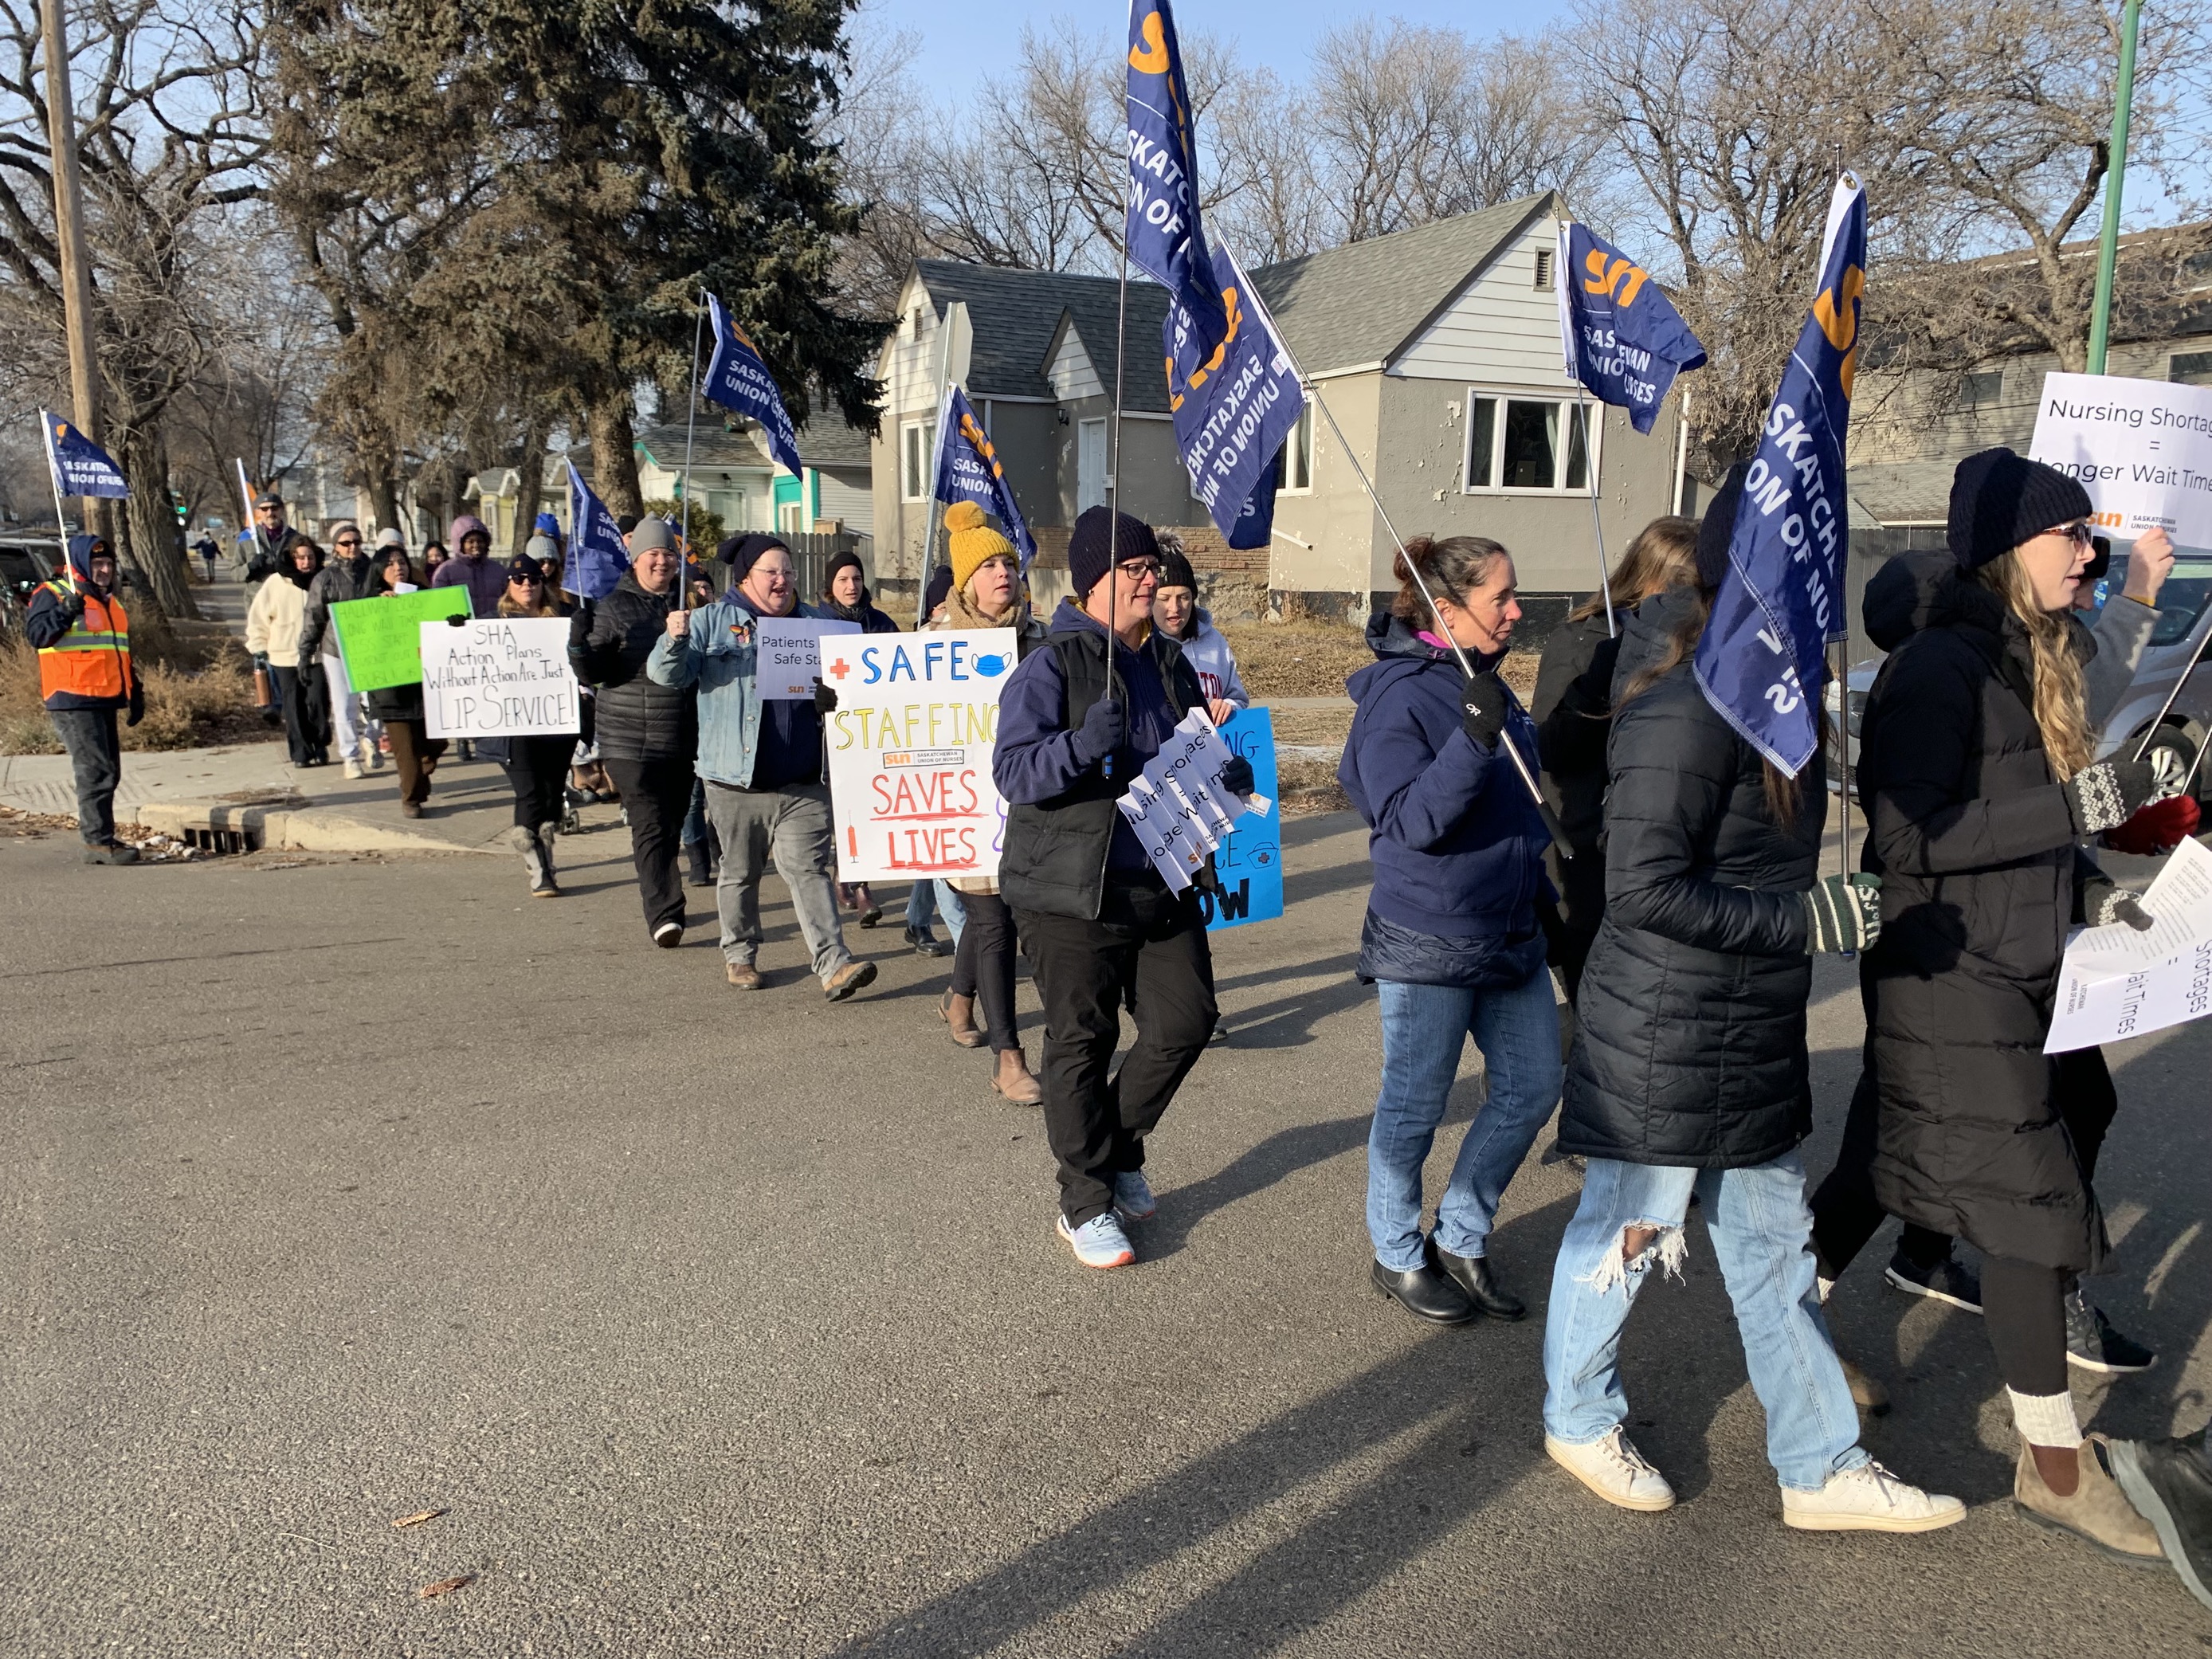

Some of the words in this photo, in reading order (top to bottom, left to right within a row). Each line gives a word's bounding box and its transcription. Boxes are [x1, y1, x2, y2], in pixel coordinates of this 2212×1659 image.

[1146, 198, 1185, 236] OF
[725, 375, 771, 406] UNION
[2049, 399, 2143, 428] Nursing
[951, 474, 994, 495] UNION
[2132, 465, 2178, 486] Wait
[1781, 512, 1812, 565] OF
[474, 624, 516, 645] SHA
[762, 636, 814, 649] Patients
[449, 646, 494, 666] Action
[507, 645, 543, 661] Plans
[775, 653, 802, 665] Safe
[861, 641, 969, 684] SAFE
[424, 665, 477, 690] Without
[481, 665, 517, 685] Action
[520, 662, 537, 682] Are
[539, 659, 566, 680] Just
[438, 691, 477, 731] LIP
[478, 680, 576, 730] SERVICE!
[884, 753, 911, 766] sun
[872, 770, 978, 814] SAVES
[888, 827, 977, 867] LIVES
[2117, 991, 2146, 1035] Times
